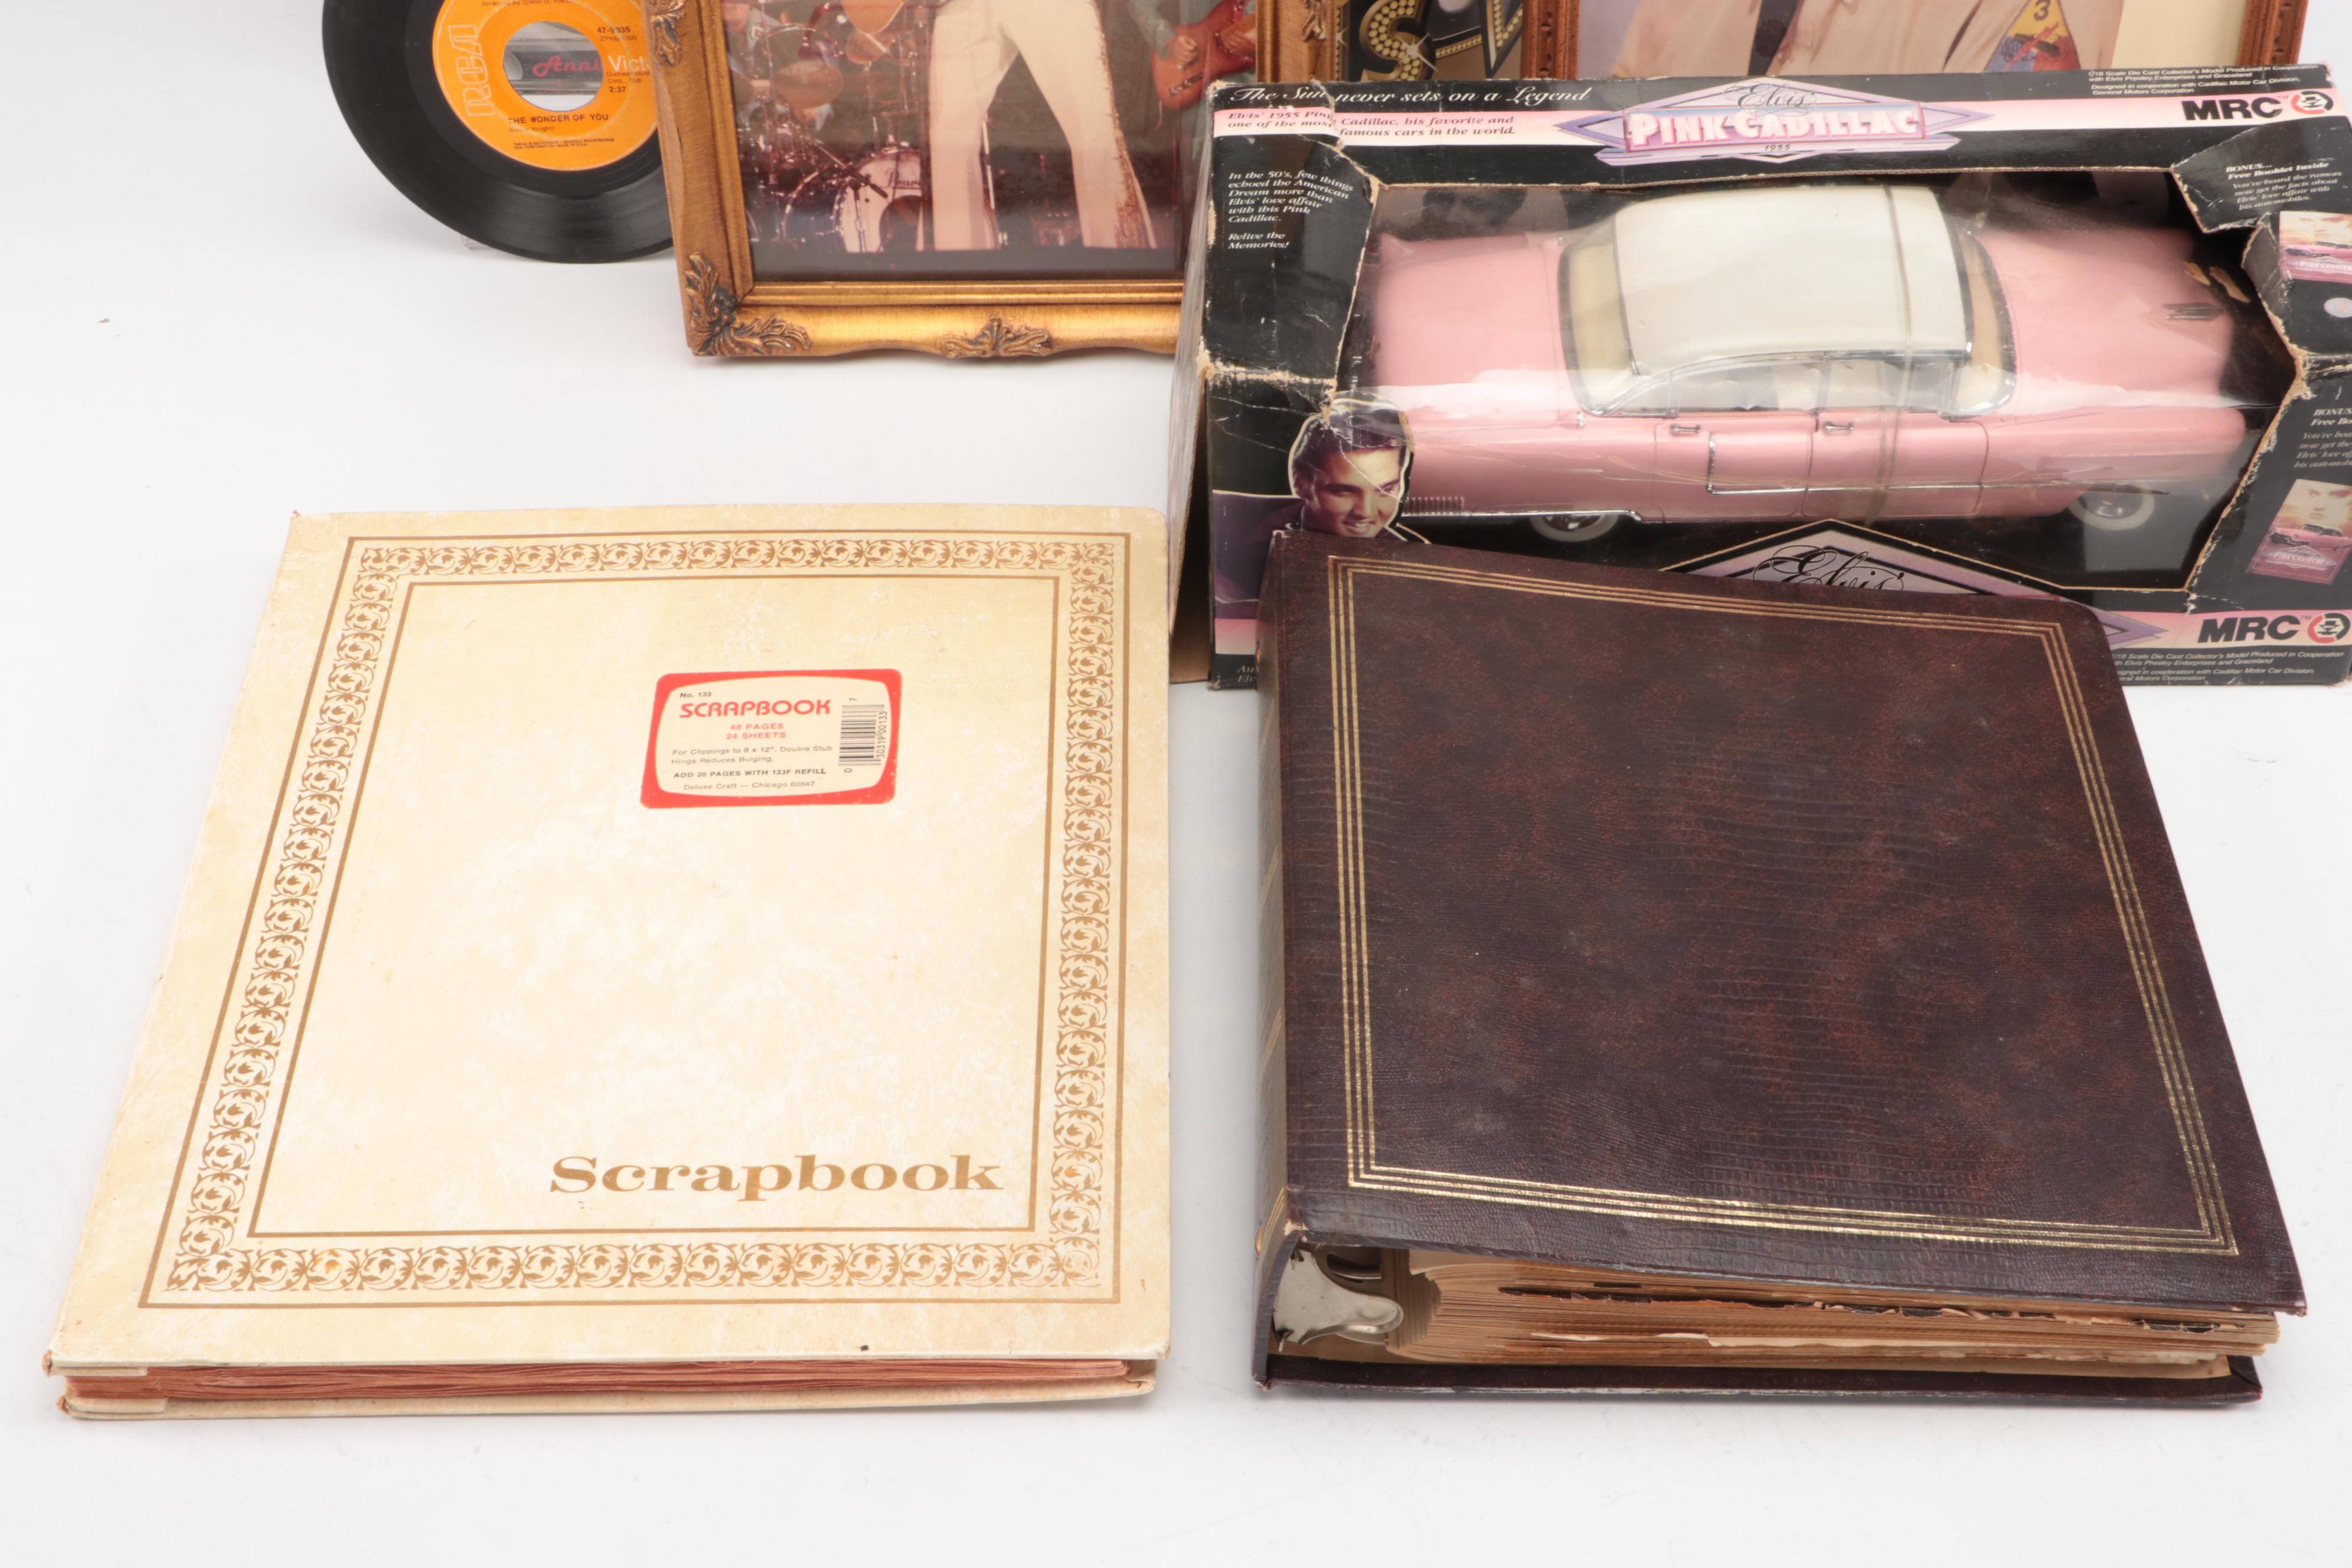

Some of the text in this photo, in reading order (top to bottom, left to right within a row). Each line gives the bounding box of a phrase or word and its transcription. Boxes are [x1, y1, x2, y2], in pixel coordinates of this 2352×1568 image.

[447, 24, 495, 116] RCA
[1230, 87, 1592, 106] The Sun never sets on a Legend
[2181, 97, 2284, 120] MRC
[531, 115, 569, 123] WONDER
[1341, 117, 1398, 126] Cadillac,
[1427, 117, 1483, 126] favorite
[1256, 120, 1273, 129] of
[1340, 128, 1389, 136] famous
[1628, 108, 1917, 147] PINK CADILLAC
[2254, 166, 2293, 177] Booklet
[2295, 162, 2330, 171] Inside
[1295, 170, 1318, 179] few
[1320, 177, 1354, 191] things
[2264, 177, 2291, 185] heard
[2288, 181, 2309, 190] facts
[1229, 179, 1270, 188] echoed
[1294, 179, 1349, 199] American
[2282, 188, 2308, 197] affair
[1229, 197, 1259, 205] Elvis'
[1288, 197, 1323, 208] affair
[1307, 191, 1333, 203] than
[1282, 205, 1311, 214] Pink
[1229, 214, 1282, 223] Cadillac.
[2197, 615, 2300, 642] MRC
[680, 699, 831, 718] SCRAPBOOK
[549, 1154, 1005, 1202] Scrapbook
